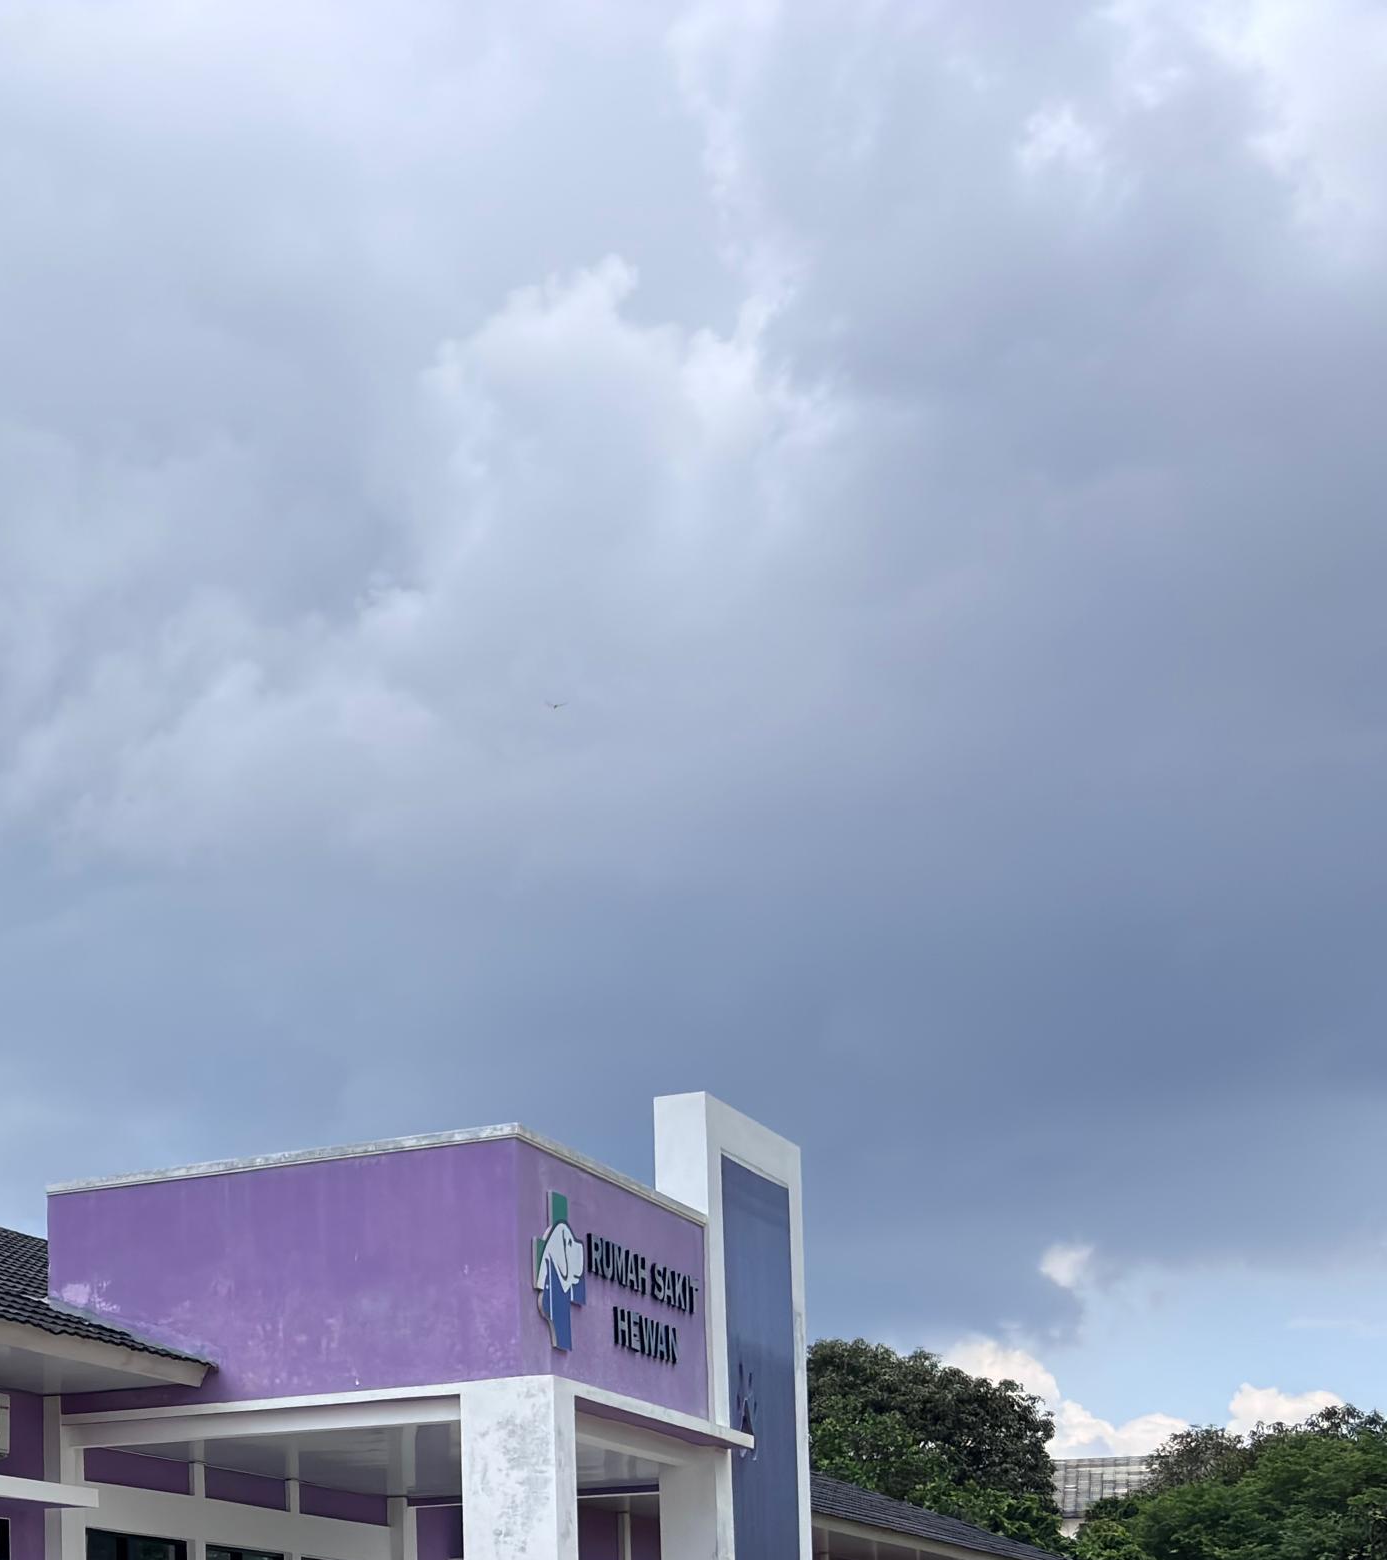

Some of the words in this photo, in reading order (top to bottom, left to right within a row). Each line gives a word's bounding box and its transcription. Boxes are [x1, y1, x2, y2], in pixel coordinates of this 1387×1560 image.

[587, 1233, 646, 1295] RUMAH
[650, 1263, 699, 1314] SAKIT
[613, 1306, 677, 1364] HEWAN
